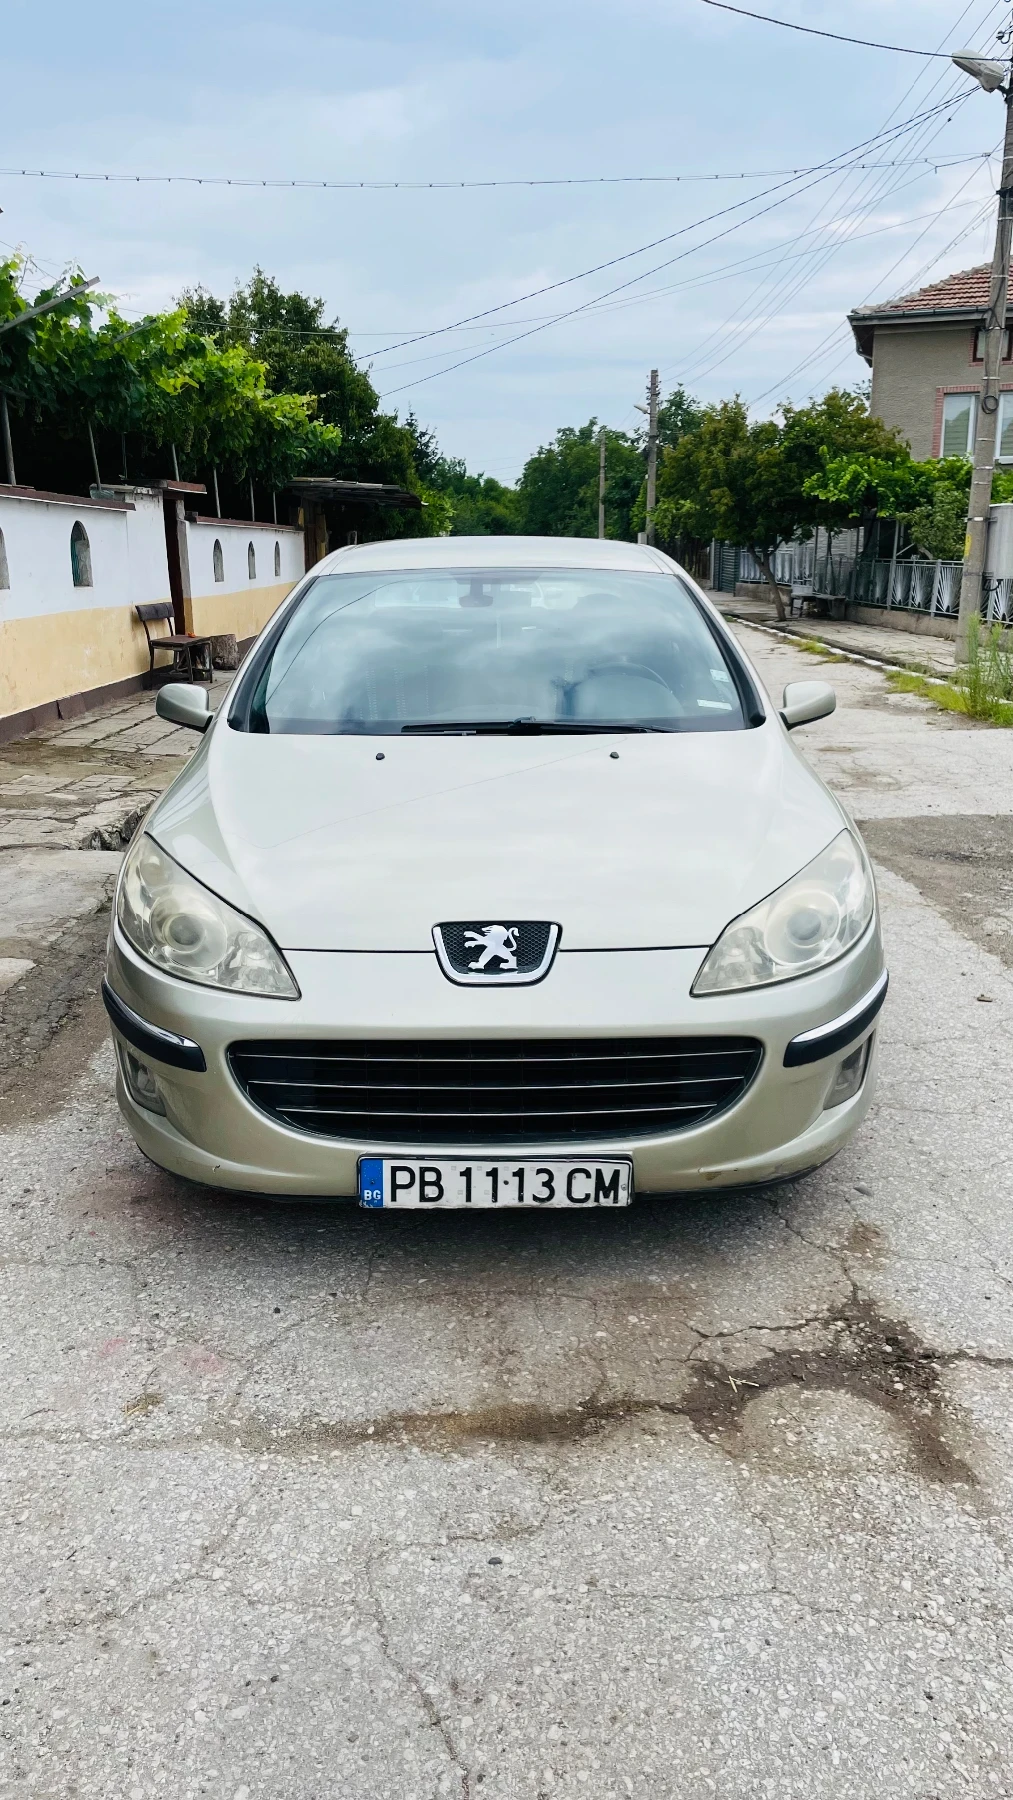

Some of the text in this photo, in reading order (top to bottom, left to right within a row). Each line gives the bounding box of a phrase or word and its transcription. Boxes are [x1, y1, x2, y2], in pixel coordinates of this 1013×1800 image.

[363, 1189, 381, 1201] BG
[390, 1165, 621, 1204] PB 1113 CM
